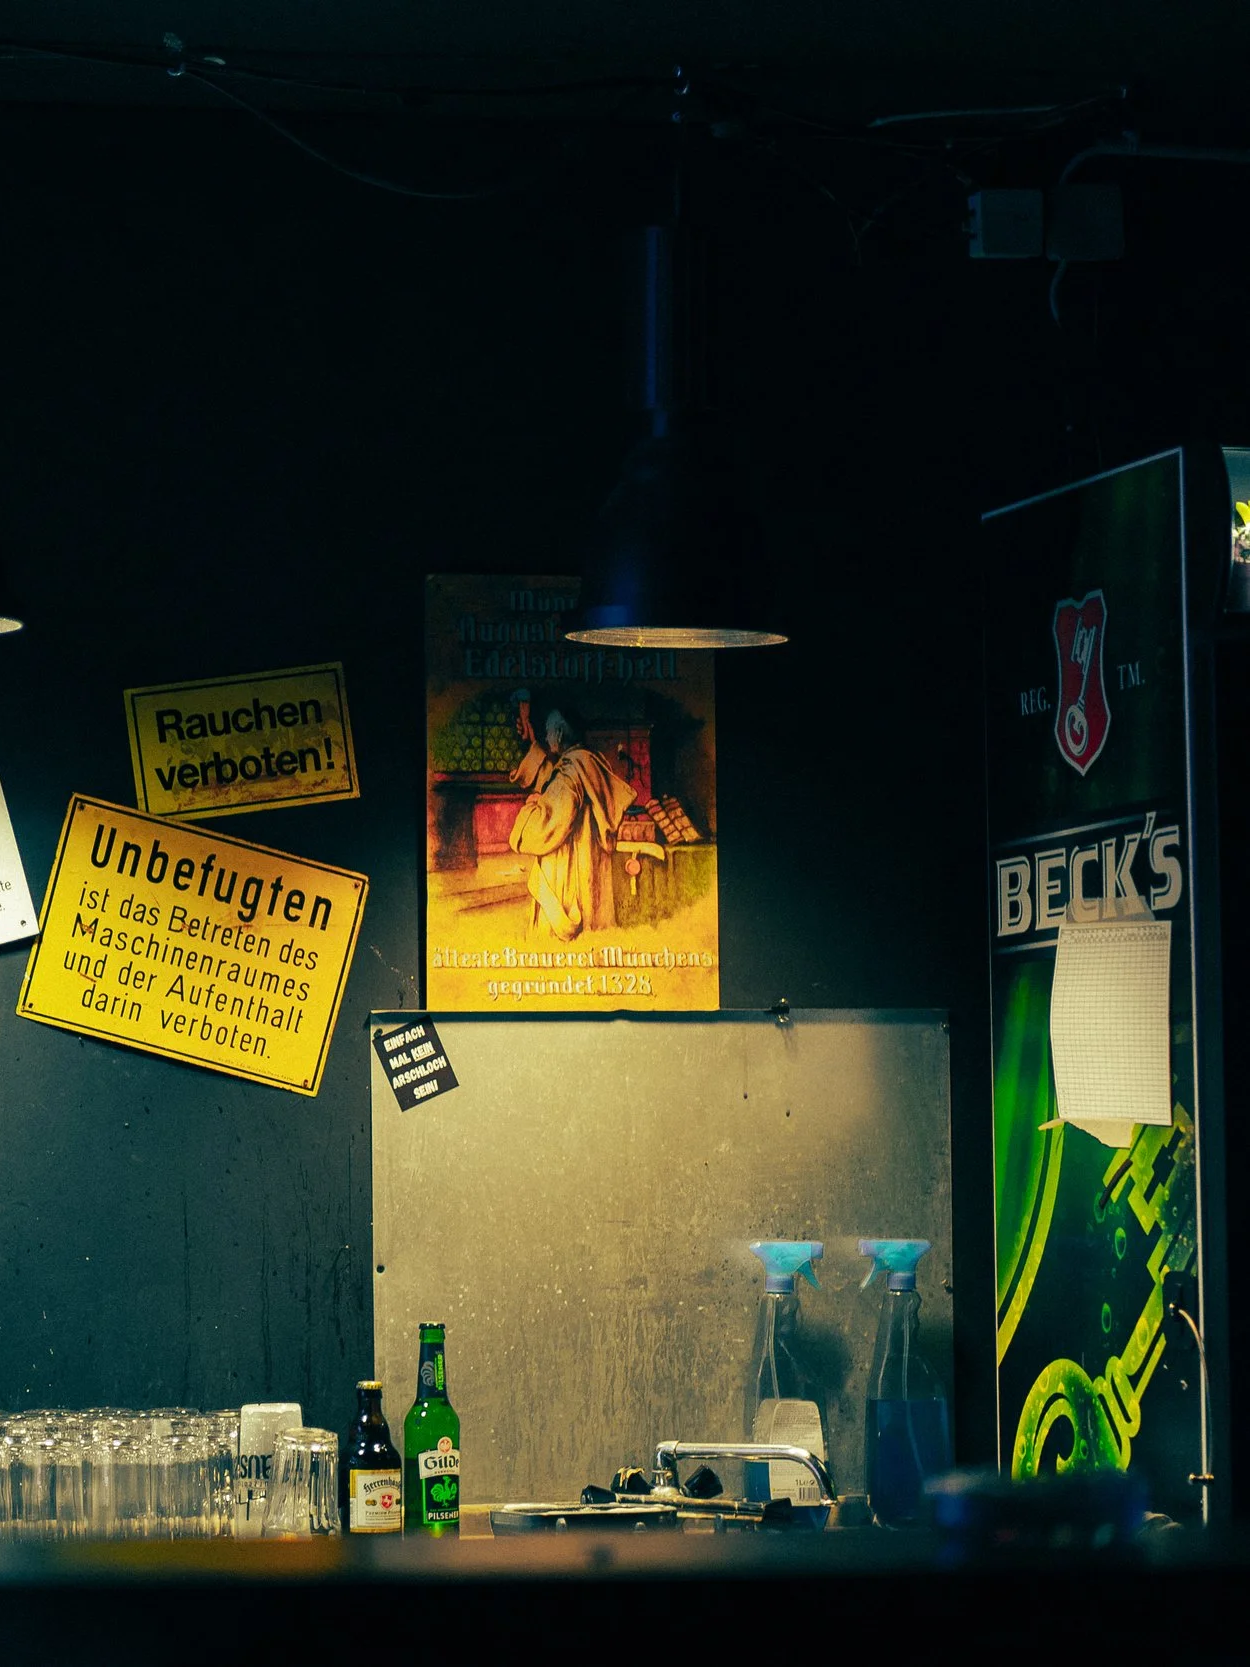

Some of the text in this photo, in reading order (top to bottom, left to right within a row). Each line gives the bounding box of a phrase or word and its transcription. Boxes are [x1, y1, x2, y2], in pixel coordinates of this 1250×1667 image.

[458, 613, 559, 645] August
[1116, 661, 1146, 691] TM.
[1020, 685, 1051, 716] REG.
[155, 698, 323, 744] Rauchen
[155, 737, 336, 792] verboten!
[90, 822, 334, 932] Unbefugten
[995, 810, 1184, 938] BECK'S
[79, 881, 319, 971] ist das Betreten des
[71, 912, 312, 1002] Maschinenraumes
[503, 947, 596, 968] Brauerei
[600, 946, 715, 972] Münchens
[63, 950, 305, 1034] und der Aufenthalt
[487, 975, 595, 1001] gegründet
[81, 984, 272, 1060] darin verboten.
[383, 1025, 426, 1053] EINFACH
[389, 1041, 436, 1070] MAL KEIN
[392, 1055, 448, 1090] ARSCHLOCH
[413, 1079, 439, 1100] SEIN!
